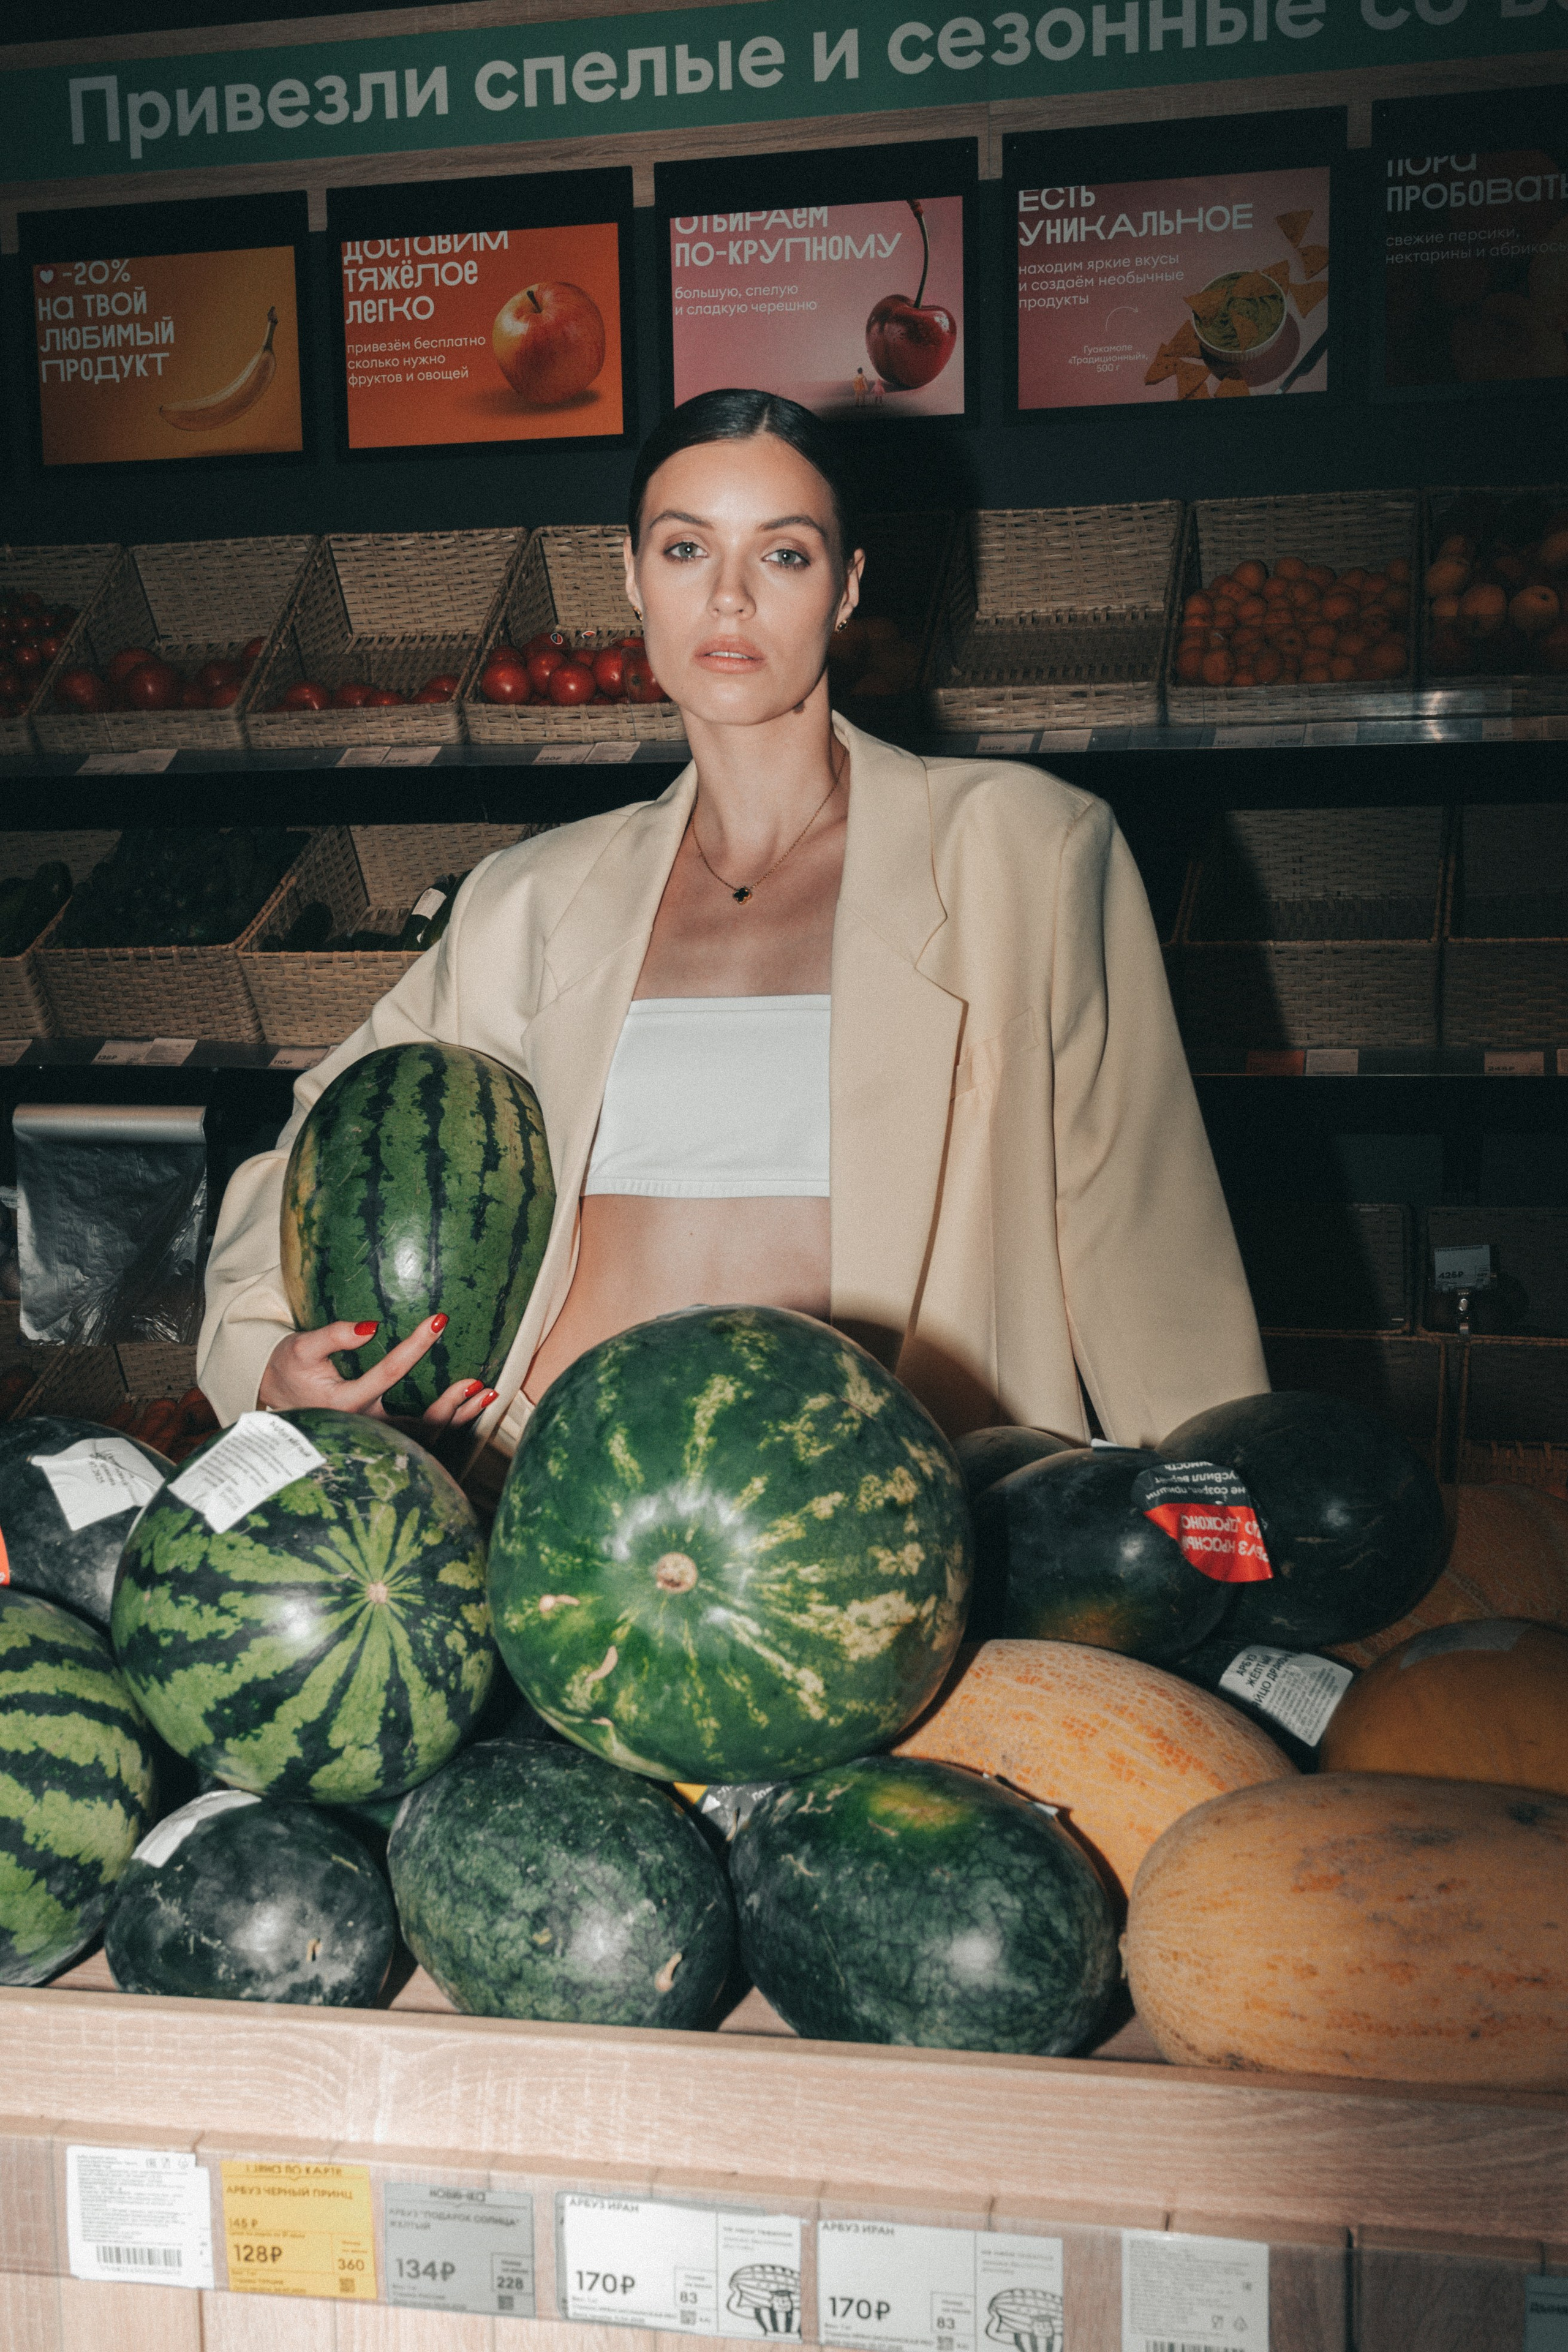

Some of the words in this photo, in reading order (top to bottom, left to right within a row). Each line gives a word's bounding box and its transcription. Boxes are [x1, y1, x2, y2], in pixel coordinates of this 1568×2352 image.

[69, 66, 449, 160] Привезли
[474, 36, 785, 112] спелые
[813, 28, 859, 83] и
[888, 0, 1325, 75] сезонные
[1018, 186, 1096, 212] ЕСТЬ
[1018, 203, 1254, 246] УНИКАЛЬНОЕ
[675, 233, 902, 267] ПО-КРУПНОМУ
[1385, 233, 1444, 247] свежие
[1019, 262, 1084, 275] находим
[1087, 255, 1131, 272] яркие
[1135, 253, 1180, 268] вкусы
[1385, 248, 1471, 265] нектарины
[1476, 248, 1485, 258] и
[62, 258, 132, 286] -20%
[1019, 282, 1028, 292] и
[1031, 275, 1095, 292] создаём
[1098, 270, 1185, 287] необычные
[82, 286, 148, 318] ТВОЙ
[674, 287, 742, 300] большую,
[745, 284, 799, 297] спелую
[1019, 294, 1090, 311] продукты
[345, 295, 435, 325] ЛЕГКО
[674, 306, 683, 315] и
[687, 301, 748, 317] сладкую
[750, 300, 818, 314] черешню
[39, 316, 175, 352] ЛЮБИМЫЙ
[347, 338, 411, 356] привезём
[414, 336, 486, 350] бесплатно
[1084, 344, 1133, 355] Гуакамоле
[41, 352, 170, 385] ПРОДУКТ
[347, 357, 400, 370] сколько
[403, 354, 446, 369] нужно
[1096, 364, 1114, 372] 500
[348, 372, 403, 388] фруктов
[417, 366, 469, 382] овощей
[1145, 1485, 1187, 1500] пришли
[1237, 1540, 1269, 1562] РБУЗ
[1236, 1654, 1257, 1676] АРБУЗ
[226, 2185, 261, 2195] АРБУЗ
[234, 2244, 282, 2263] 128₽
[338, 2258, 365, 2271] 360
[396, 2257, 456, 2282] 134₽
[575, 2271, 635, 2294] 170₽
[679, 2291, 698, 2304] 83
[829, 2297, 891, 2320] 170₽
[937, 2317, 956, 2331] 83
